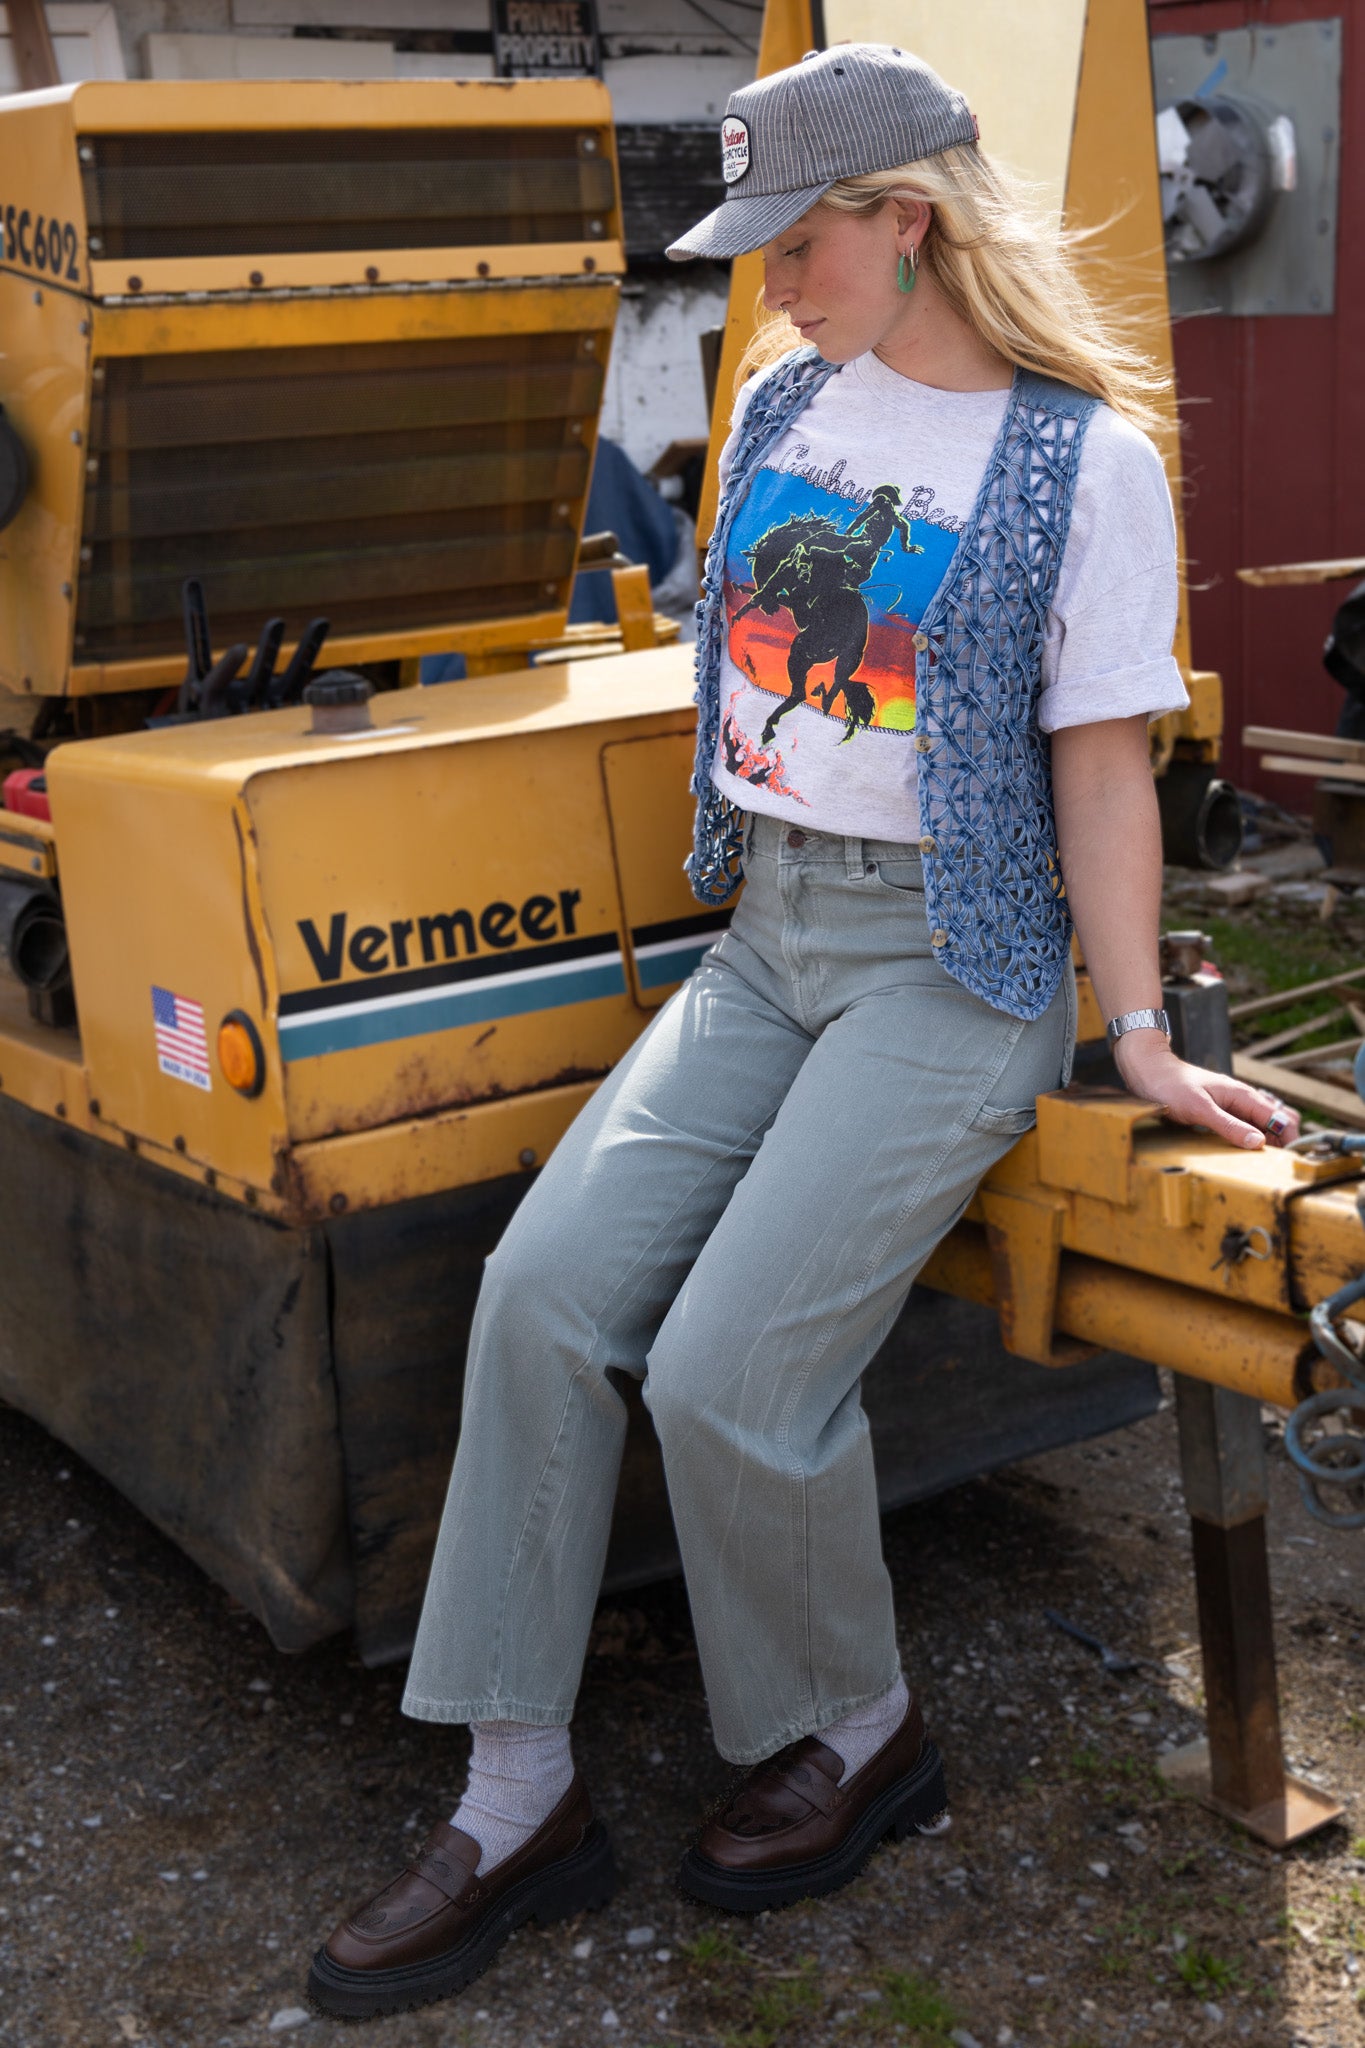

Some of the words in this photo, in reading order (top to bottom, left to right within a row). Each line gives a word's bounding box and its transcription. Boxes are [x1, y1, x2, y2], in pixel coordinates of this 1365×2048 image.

[507, 3, 582, 33] PRIVATE
[498, 34, 594, 66] PROPERTY
[778, 443, 872, 512] Cowboy
[296, 889, 581, 982] Vermeer
